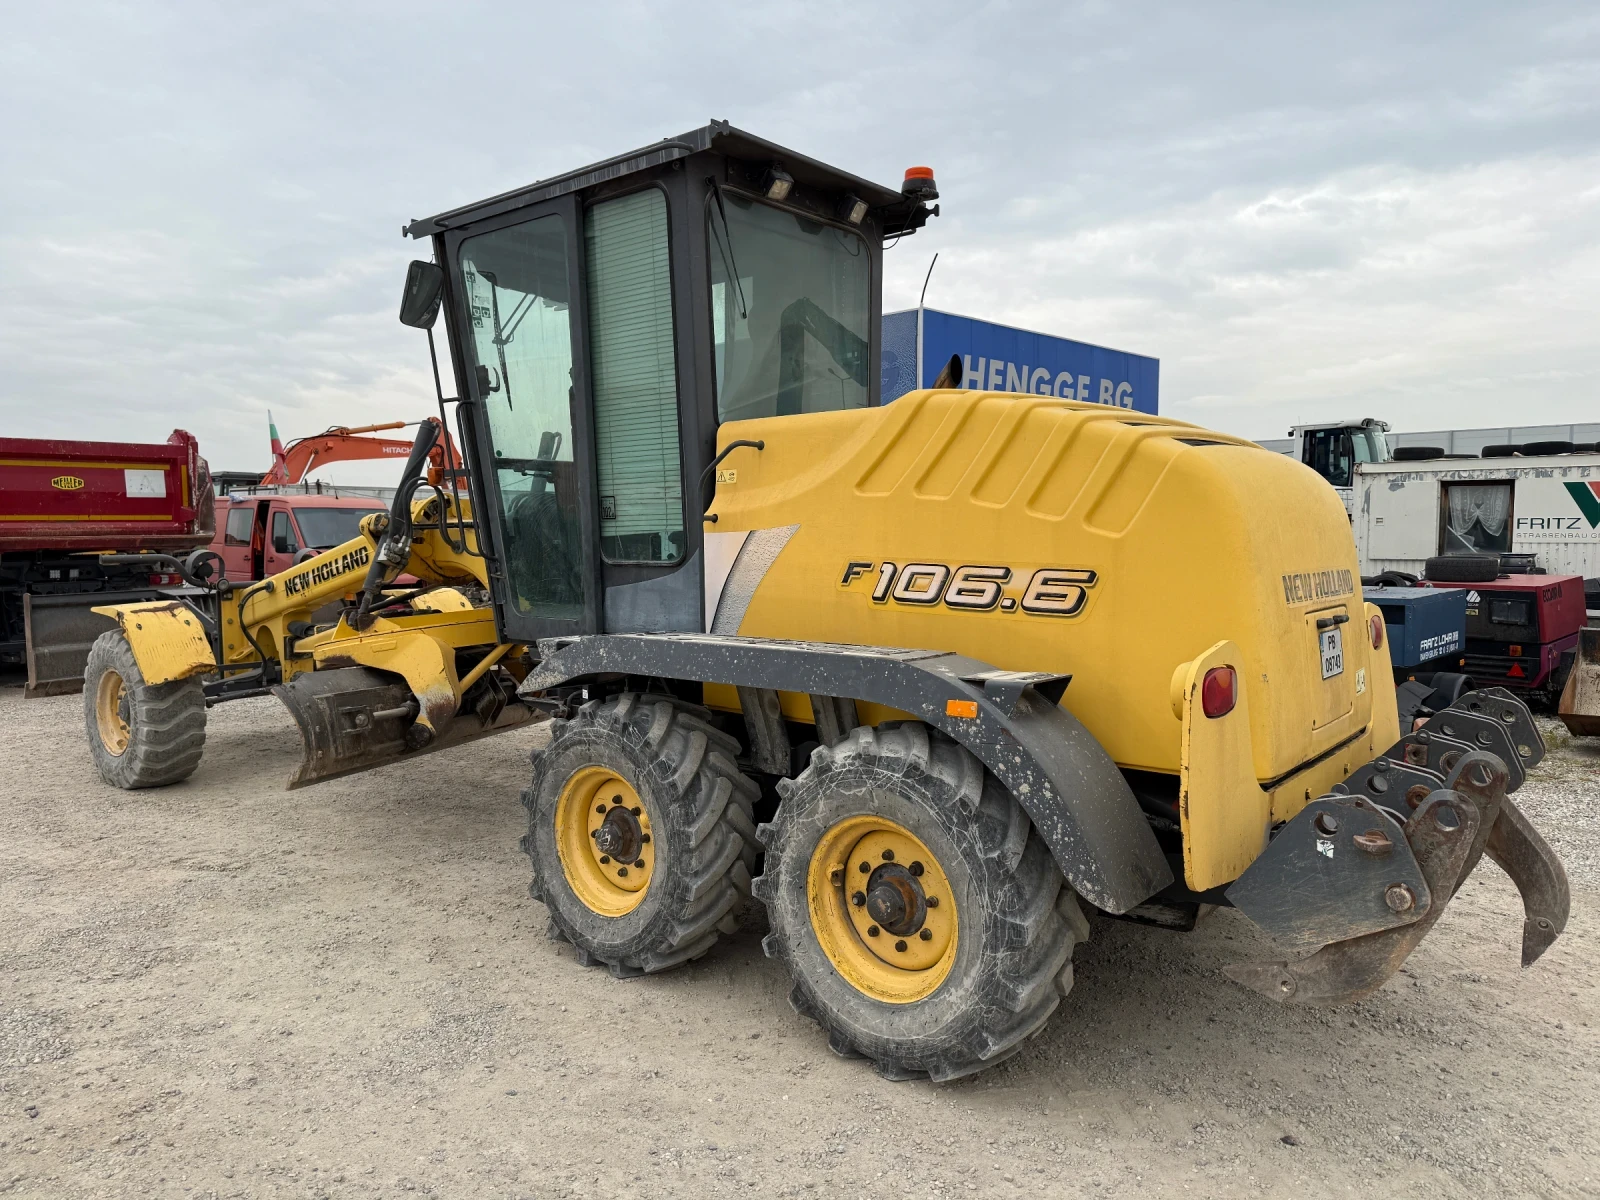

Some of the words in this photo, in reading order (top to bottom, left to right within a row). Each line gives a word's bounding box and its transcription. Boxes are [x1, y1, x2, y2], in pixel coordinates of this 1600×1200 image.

[961, 354, 1091, 402] HENGGE
[1099, 378, 1134, 409] BG
[382, 446, 413, 454] HITACH
[52, 477, 83, 488] MEILLER
[1516, 517, 1581, 530] FRITZ
[284, 571, 310, 597] NEW
[311, 545, 370, 586] HOLLAND
[1282, 573, 1313, 604] NEW
[1312, 569, 1354, 599] HOLLAND
[1327, 634, 1336, 651] PB
[1325, 653, 1341, 673] 08743
